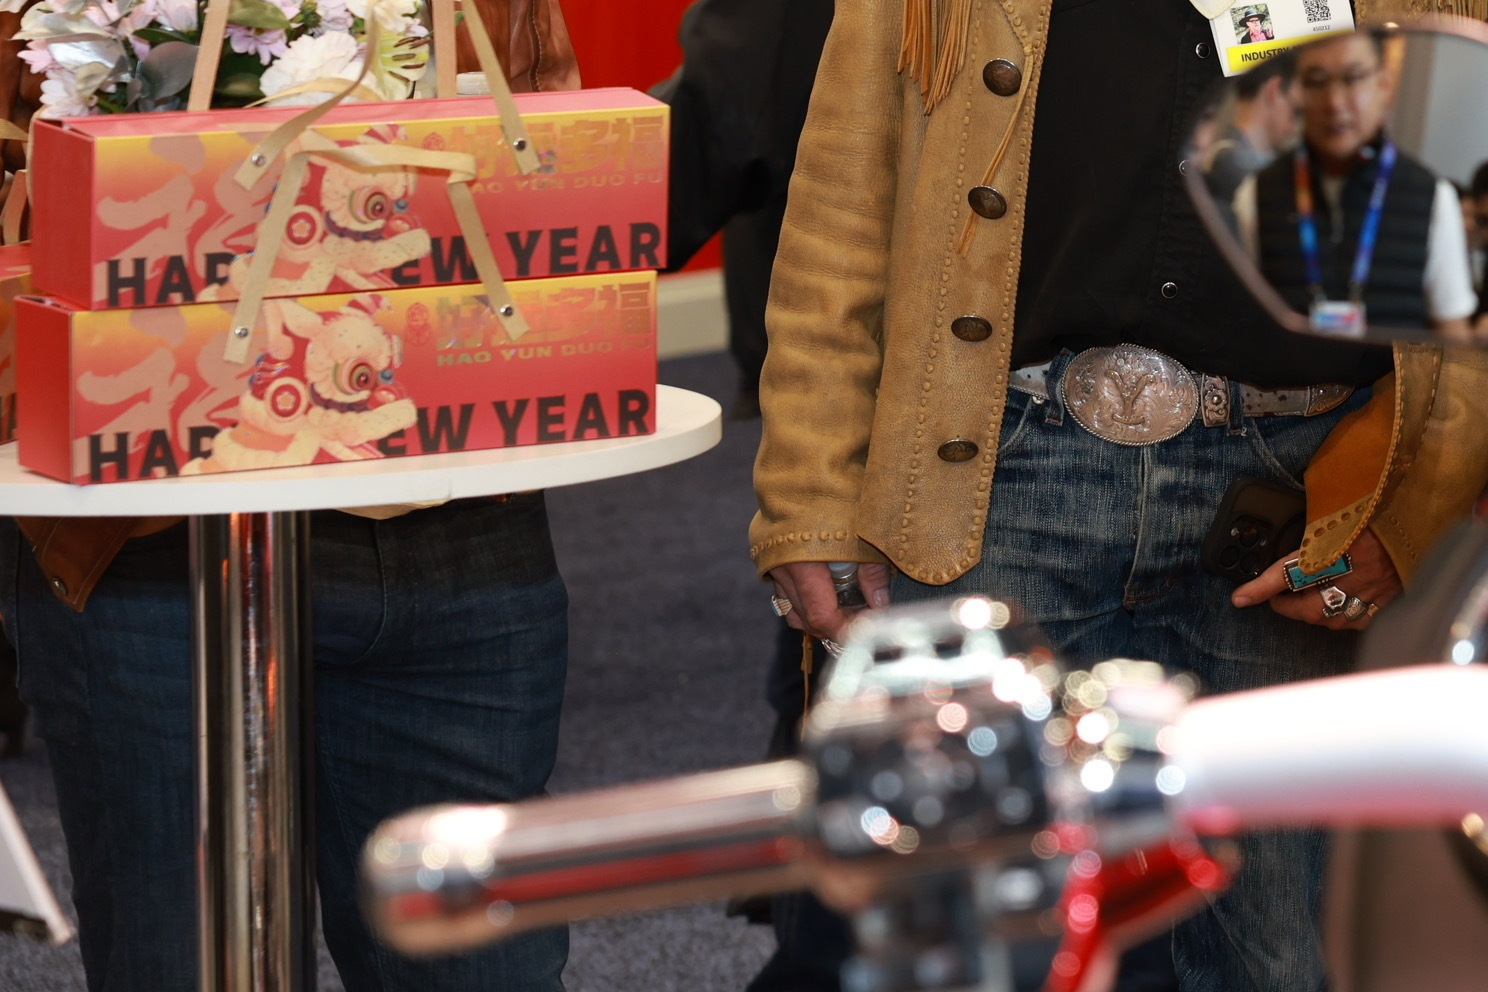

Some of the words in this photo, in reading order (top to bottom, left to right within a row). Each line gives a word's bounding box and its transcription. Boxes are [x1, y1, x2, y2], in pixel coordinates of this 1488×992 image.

[471, 181, 504, 194] AO
[573, 174, 626, 189] DUO
[108, 252, 237, 307] HAP
[391, 234, 491, 287] EW
[506, 222, 661, 278] YEAR
[437, 351, 492, 367] HAO
[502, 345, 552, 361] YUN
[89, 426, 222, 482] HAP
[377, 403, 475, 455] EW
[492, 389, 650, 446] YEAR
